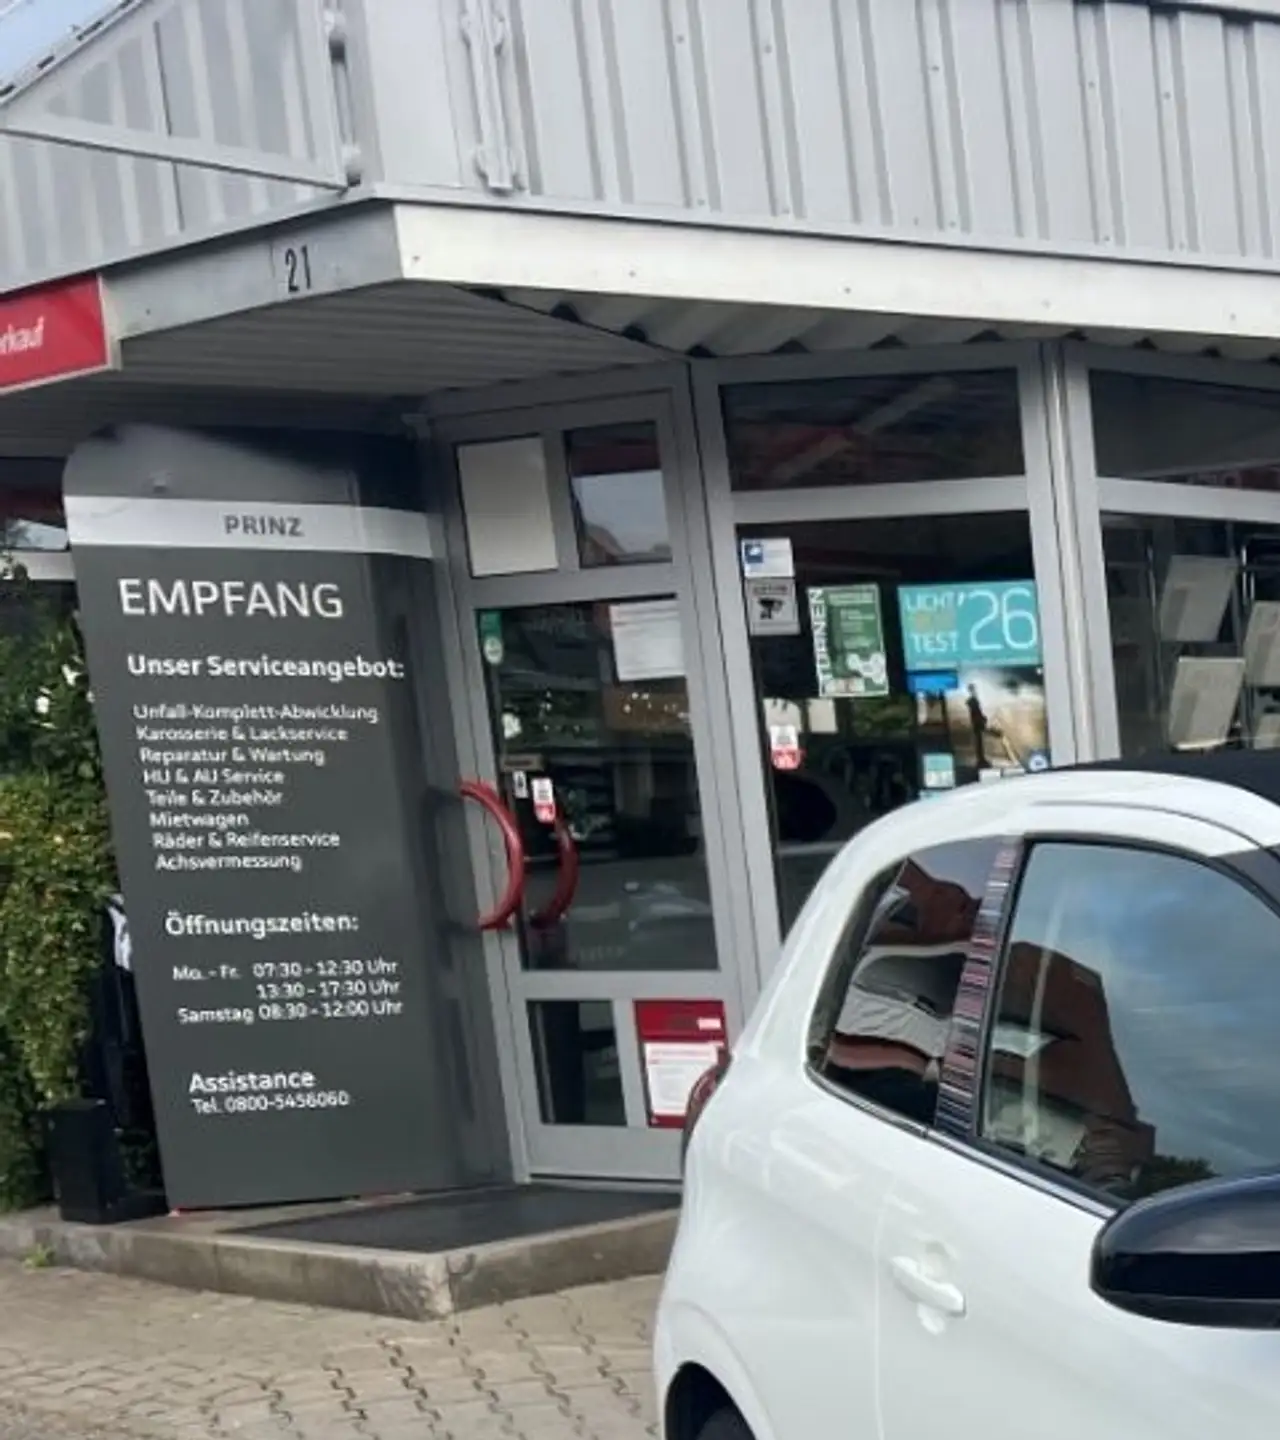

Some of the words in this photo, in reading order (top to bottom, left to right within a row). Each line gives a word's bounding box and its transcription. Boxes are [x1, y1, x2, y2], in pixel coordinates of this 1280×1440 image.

[283, 245, 312, 293] 21
[223, 514, 304, 538] PRINZ
[117, 578, 344, 618] EMPFANG
[909, 630, 958, 654] TEST
[127, 653, 203, 677] Unser
[206, 654, 405, 682] Serviceangebot:
[133, 703, 379, 724] Unfall-Komplett-Abwicklung
[136, 726, 228, 741] Karosserie
[231, 726, 246, 741] &
[250, 726, 348, 741] Lackservice
[139, 747, 227, 766] Reparatur
[231, 747, 245, 762] &
[249, 747, 325, 767] Wartung
[143, 768, 171, 784] HU
[175, 769, 189, 784] &
[193, 769, 218, 784] AU
[222, 769, 284, 784] Service
[145, 789, 187, 806] Teile
[191, 790, 206, 806] &
[208, 789, 283, 806] Zubehör
[149, 813, 249, 831] Mietwagen
[152, 832, 204, 849] Räder
[207, 833, 223, 848] &
[226, 832, 340, 848] Reifenservice
[155, 854, 302, 873] Achsvermessung
[165, 908, 359, 940] Öffnungszeiten:
[252, 962, 302, 979] 07:30
[316, 960, 363, 978] 12:30
[366, 956, 399, 976] Uhr
[256, 982, 306, 1000] 13:30
[319, 980, 367, 998] 17:30
[369, 979, 402, 996] Uhr
[177, 1006, 255, 1026] Samstag
[322, 999, 369, 1018] 12:00
[372, 998, 404, 1016] Uhr
[189, 1068, 316, 1094] Assistance
[191, 1096, 222, 1114] Tel.
